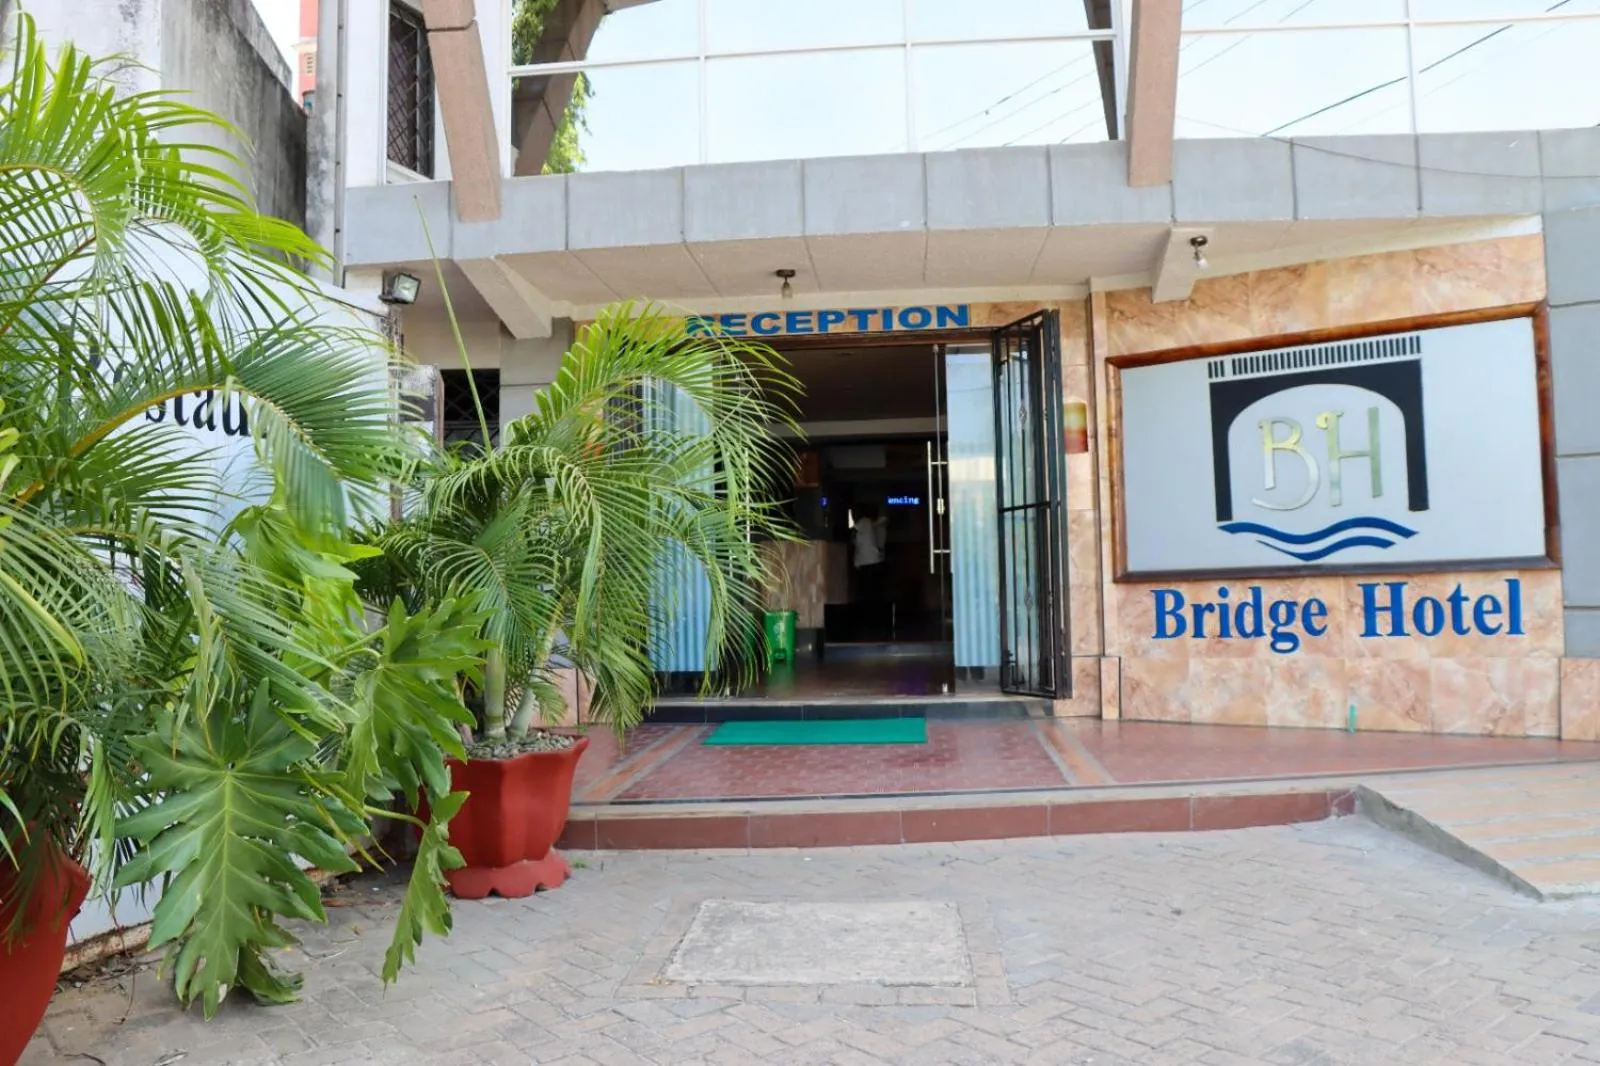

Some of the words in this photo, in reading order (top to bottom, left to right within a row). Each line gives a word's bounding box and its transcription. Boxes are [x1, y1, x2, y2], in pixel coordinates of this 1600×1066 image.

[685, 304, 970, 338] RECEPTION
[1251, 406, 1384, 511] BH
[1150, 586, 1328, 653] Bridge
[1357, 579, 1525, 637] Hotel
